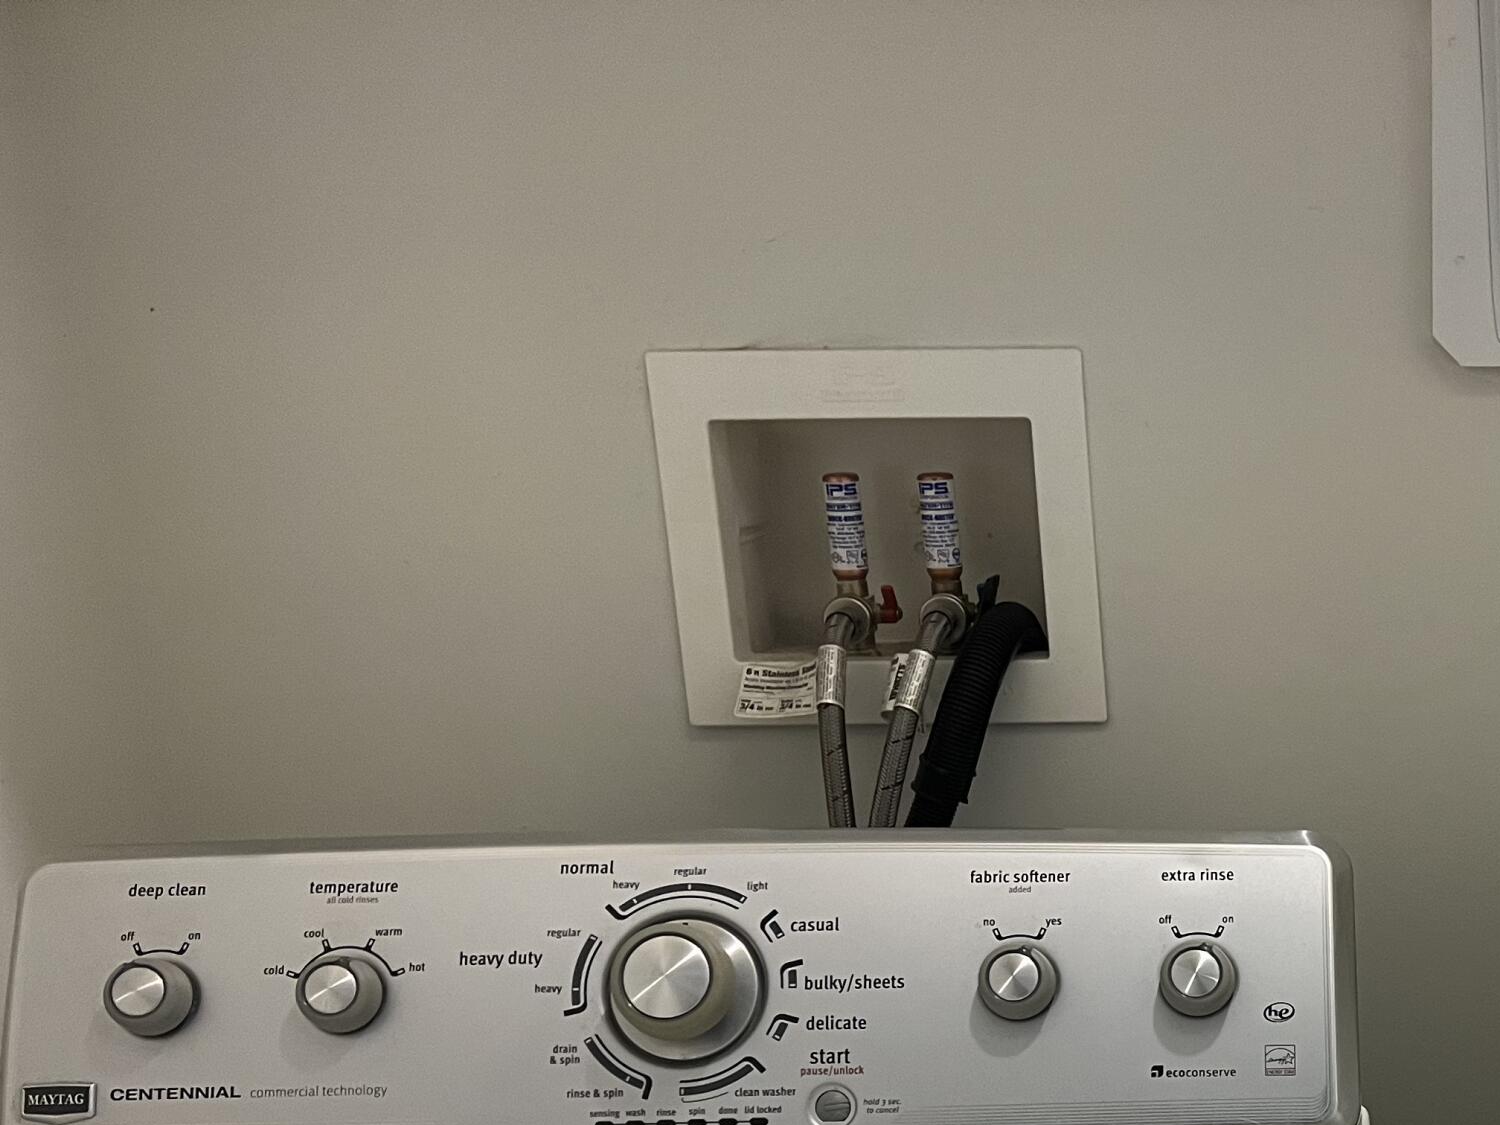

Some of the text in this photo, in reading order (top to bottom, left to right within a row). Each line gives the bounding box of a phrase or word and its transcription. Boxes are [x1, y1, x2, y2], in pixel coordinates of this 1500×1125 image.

[826, 483, 857, 496] IPS
[560, 860, 615, 876] normal
[673, 866, 707, 878] regular
[970, 870, 1071, 883] fabric softener
[1161, 869, 1234, 881] extra rinse
[128, 882, 206, 899] deep clean
[309, 880, 399, 896] temperature
[612, 879, 640, 891] heavy
[747, 880, 768, 892] light
[790, 917, 840, 932] casual
[983, 918, 995, 926] no
[1045, 917, 1062, 928] yes
[1158, 915, 1173, 924] off
[1222, 915, 1234, 923] on
[120, 931, 135, 941] off
[188, 932, 201, 940] on
[304, 928, 325, 938] cool
[375, 927, 403, 937] warm
[547, 928, 581, 938] regular
[459, 951, 543, 968] heavy duty
[263, 965, 284, 975] cold
[409, 962, 426, 972] hot
[804, 974, 905, 992] bulky/sheets
[534, 984, 562, 995] heavy
[806, 1016, 867, 1031] delicate
[552, 1044, 578, 1055] drain
[550, 1055, 580, 1066] & spin
[810, 1049, 850, 1065] start
[800, 1065, 864, 1078] pause/unlock
[1166, 1067, 1236, 1078] ecoconserve
[110, 1084, 388, 1101] CENTENNIAL commercial technology
[566, 1088, 624, 1100] rinse & spin
[734, 1087, 796, 1097] clean washer
[27, 1093, 85, 1106] MAYTAG
[863, 1098, 880, 1106] hold
[590, 1105, 782, 1119] sensing wash rinse spin done lid locked
[875, 1106, 899, 1114] cancel
